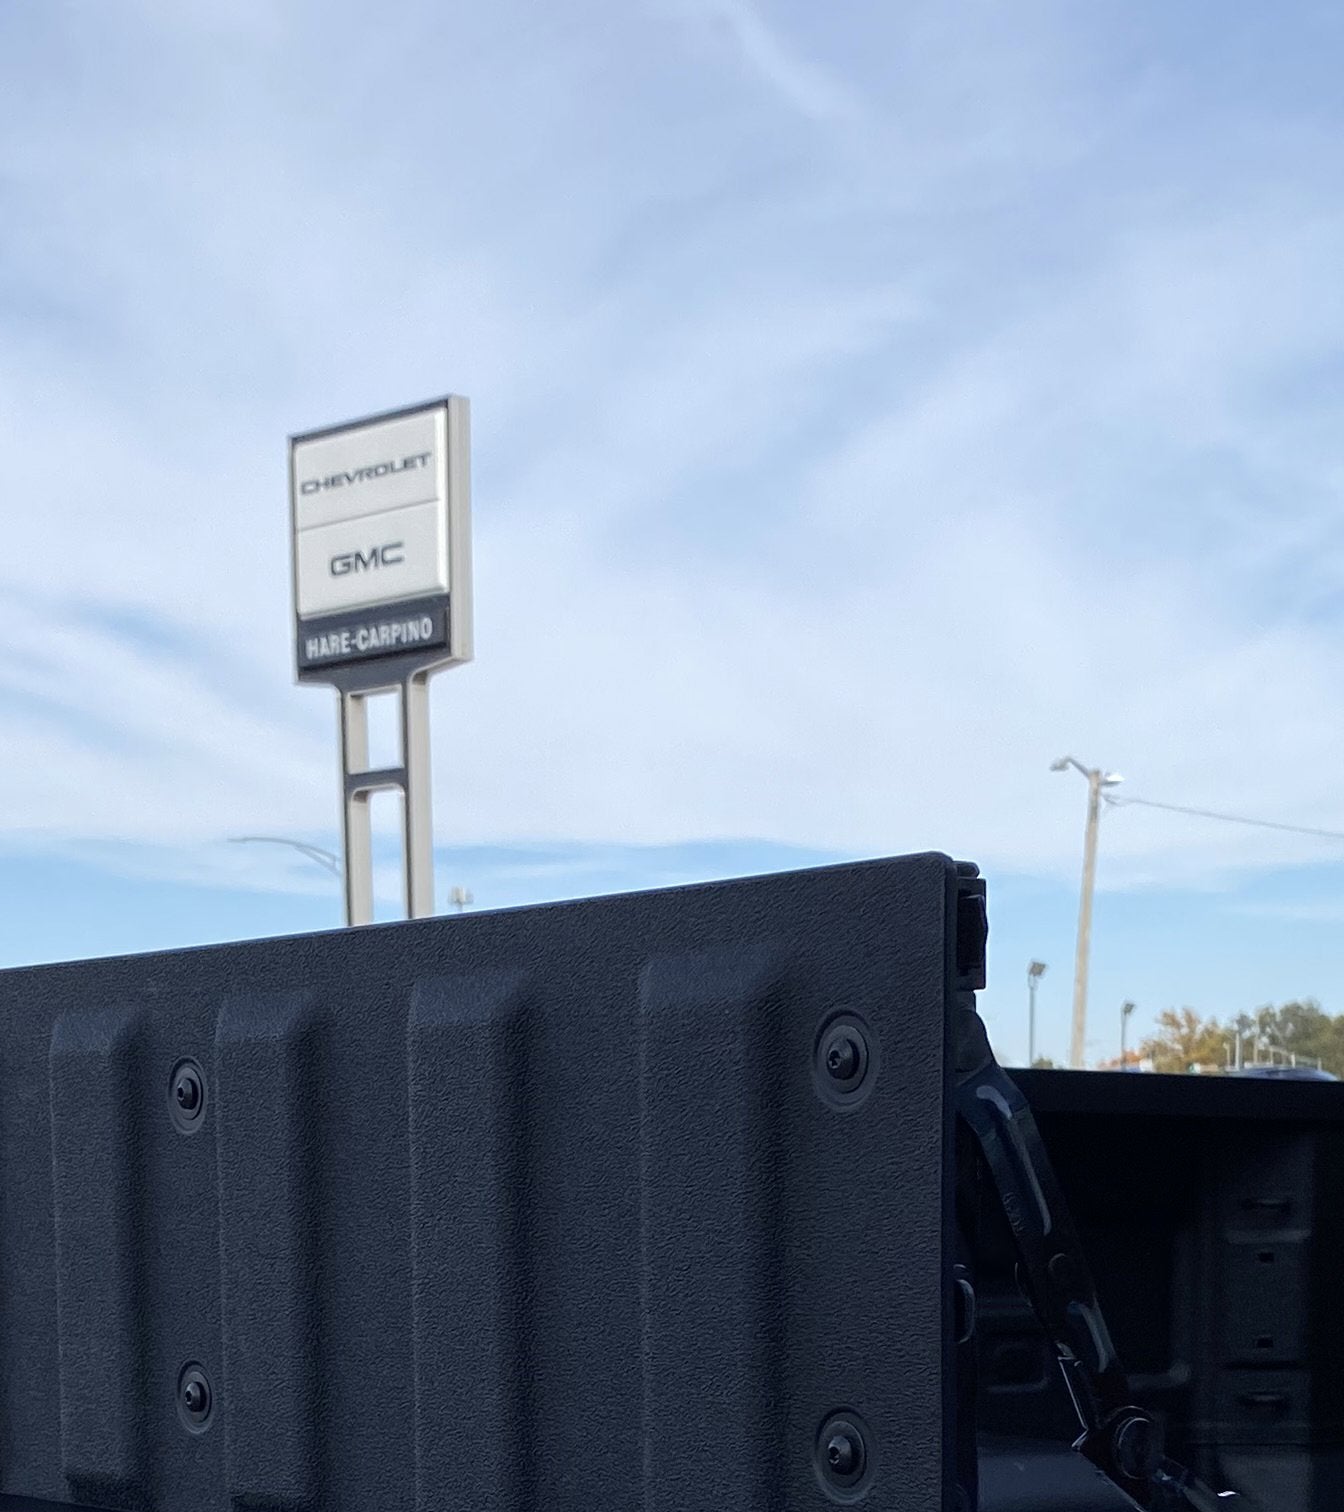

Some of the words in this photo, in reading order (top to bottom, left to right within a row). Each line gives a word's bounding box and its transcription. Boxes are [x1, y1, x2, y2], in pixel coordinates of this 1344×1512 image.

[300, 452, 431, 496] CHEVROLET
[330, 541, 404, 578] GMC
[306, 617, 433, 660] HARE-CARPINO
